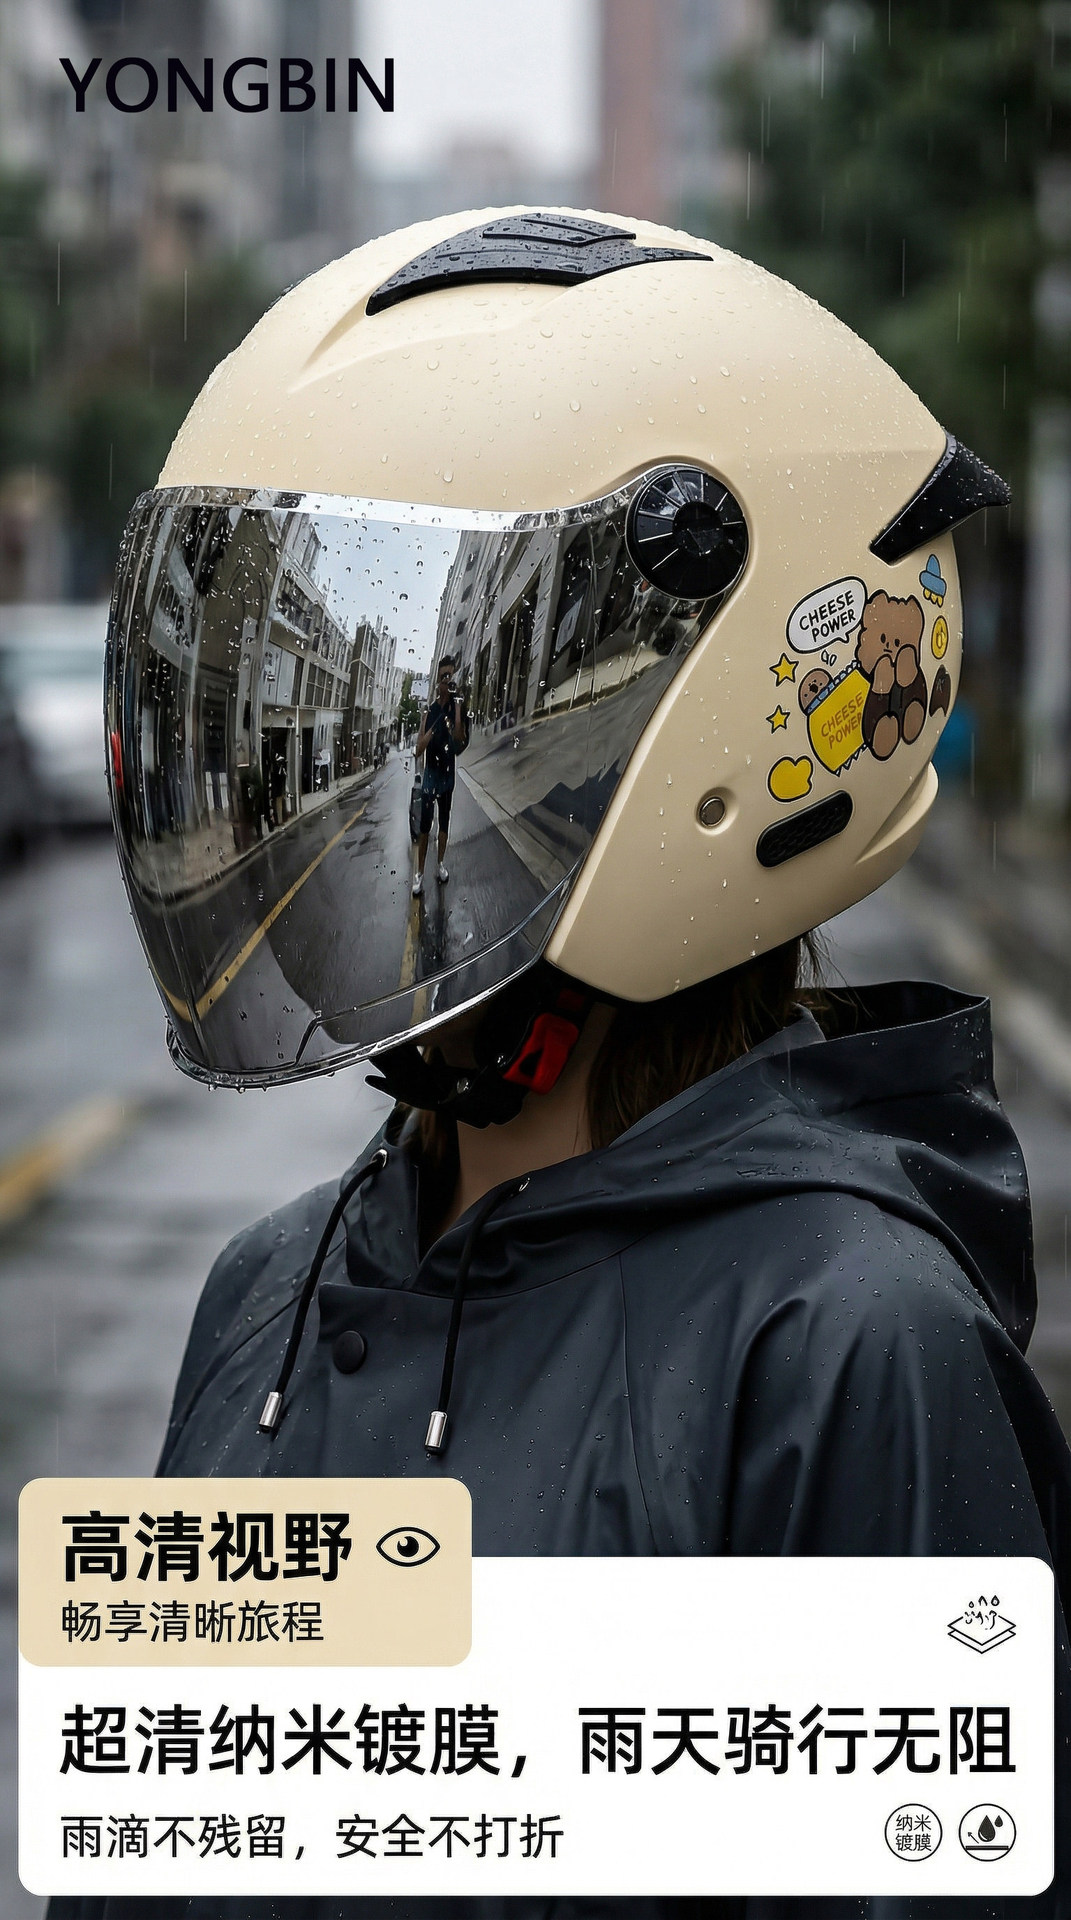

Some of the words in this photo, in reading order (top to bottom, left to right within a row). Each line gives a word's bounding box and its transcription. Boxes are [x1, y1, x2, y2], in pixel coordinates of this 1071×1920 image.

[799, 590, 854, 630] CHEESE
[811, 608, 856, 643] POWER
[821, 691, 864, 737] CHEESE
